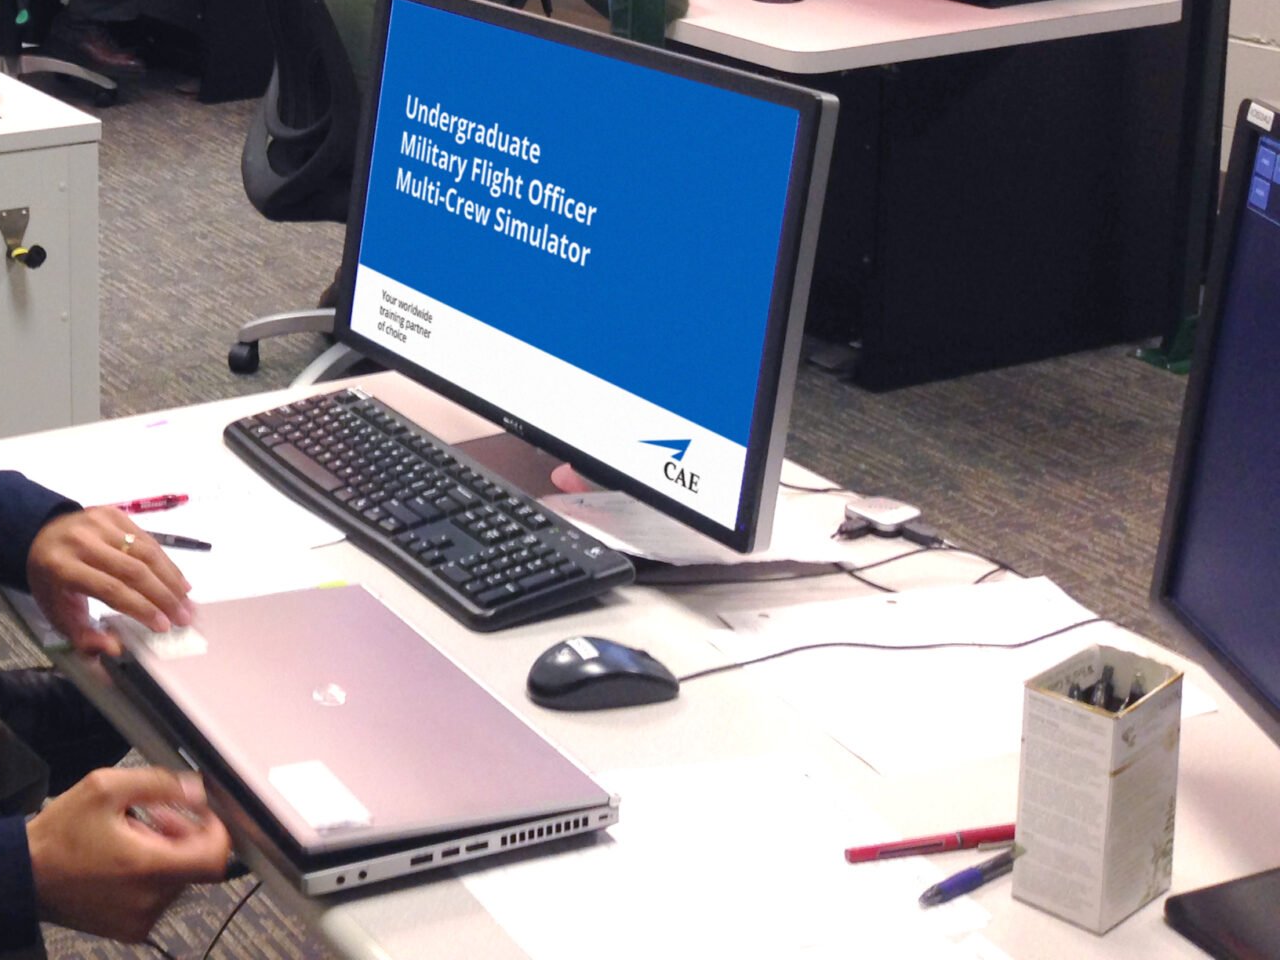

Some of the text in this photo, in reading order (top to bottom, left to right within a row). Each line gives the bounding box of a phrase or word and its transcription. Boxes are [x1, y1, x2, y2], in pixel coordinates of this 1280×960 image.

[405, 94, 541, 164] Undergraduate
[400, 131, 597, 226] Military Flight Officer
[396, 167, 591, 267] Multi-Crew Simulator
[379, 305, 431, 339] training partner
[382, 289, 433, 324] Your worldwide
[377, 321, 407, 343] of choice
[663, 461, 700, 494] CAE
